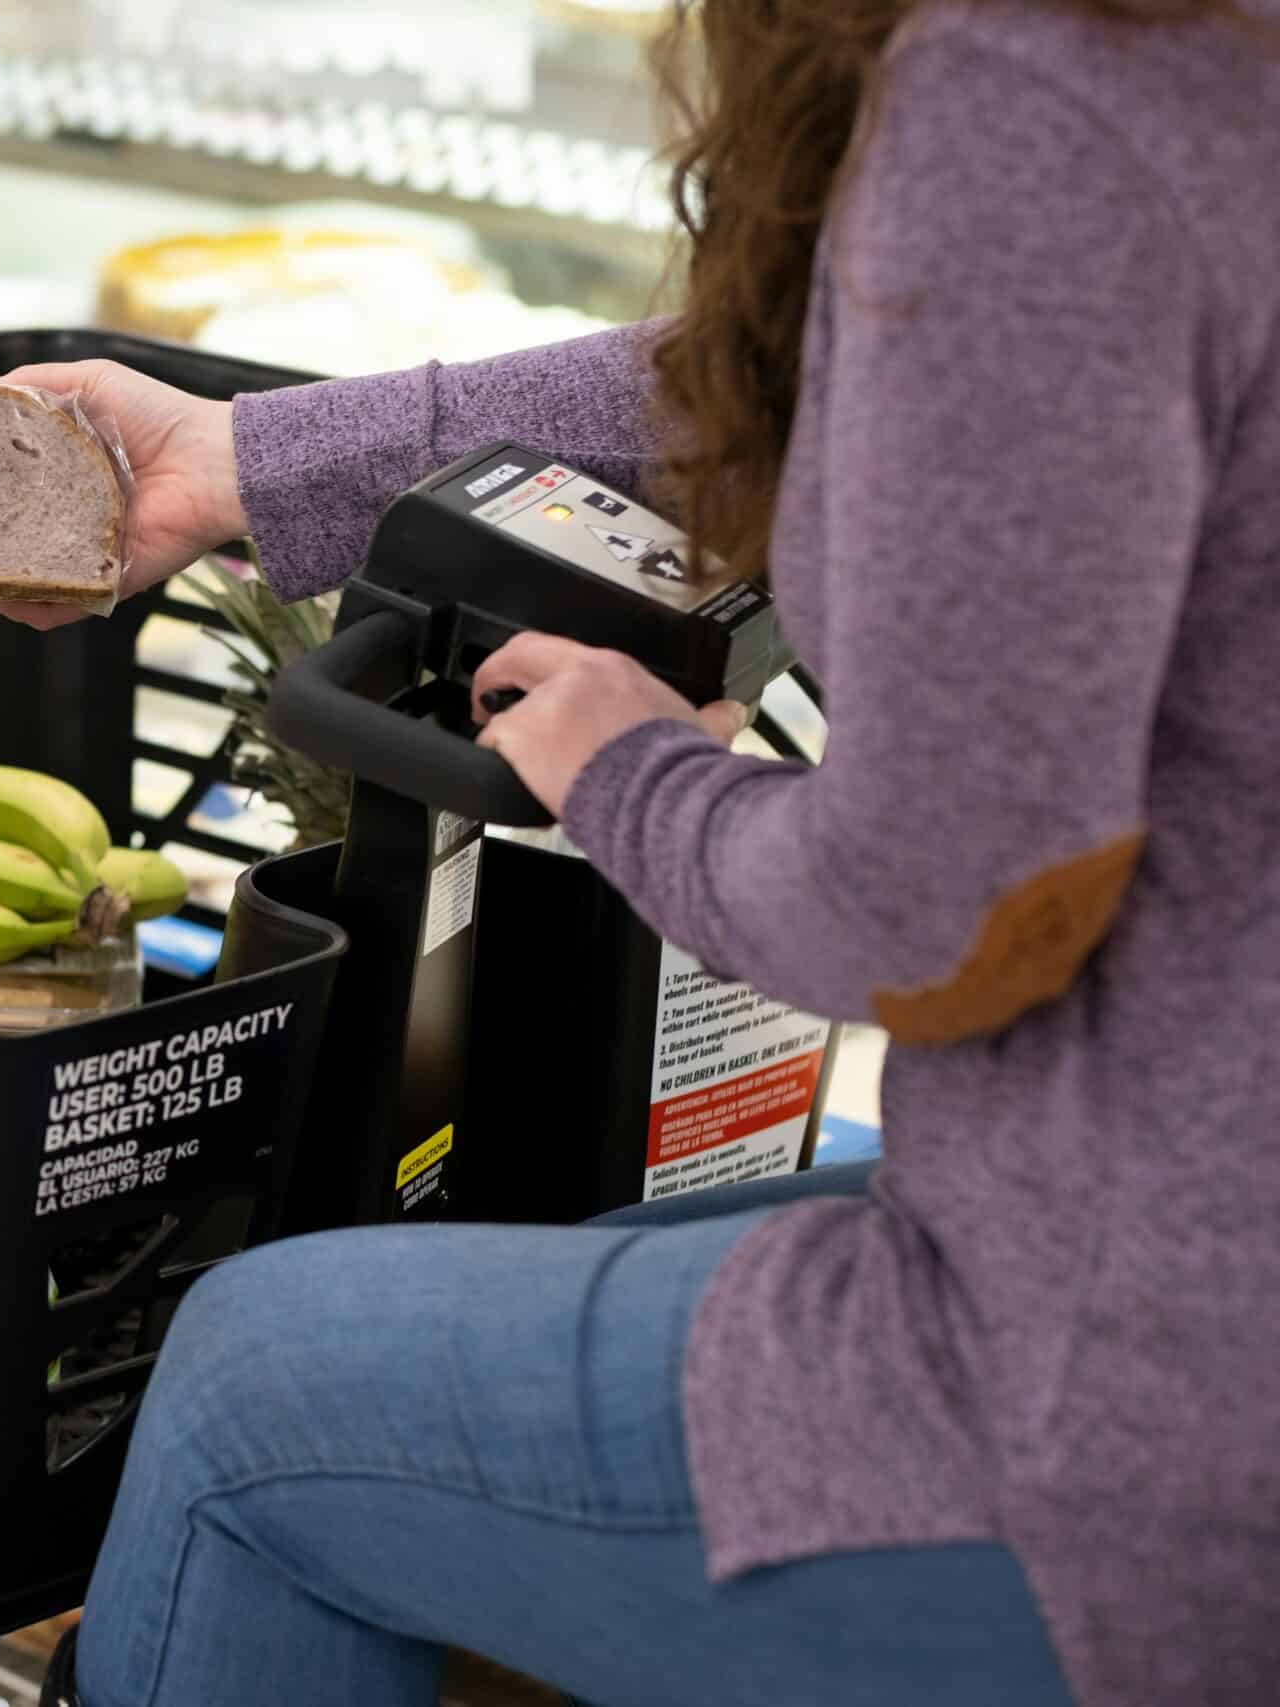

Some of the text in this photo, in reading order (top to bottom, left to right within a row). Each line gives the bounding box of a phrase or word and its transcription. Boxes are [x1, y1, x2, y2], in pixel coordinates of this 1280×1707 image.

[53, 1002, 293, 1091] WEIGHT CAPACITY
[48, 1053, 225, 1122] USER: 500 LB
[660, 1078, 673, 1092] NO
[674, 1065, 716, 1088] CHILDREN
[718, 1061, 727, 1075] IN
[44, 1075, 243, 1152] BASKET: 125 LB
[37, 1139, 200, 1198] EL USUARIO: 227 KG
[39, 1139, 138, 1179] CAPACIDAD
[35, 1165, 167, 1216] LA CESTA: 57 KG
